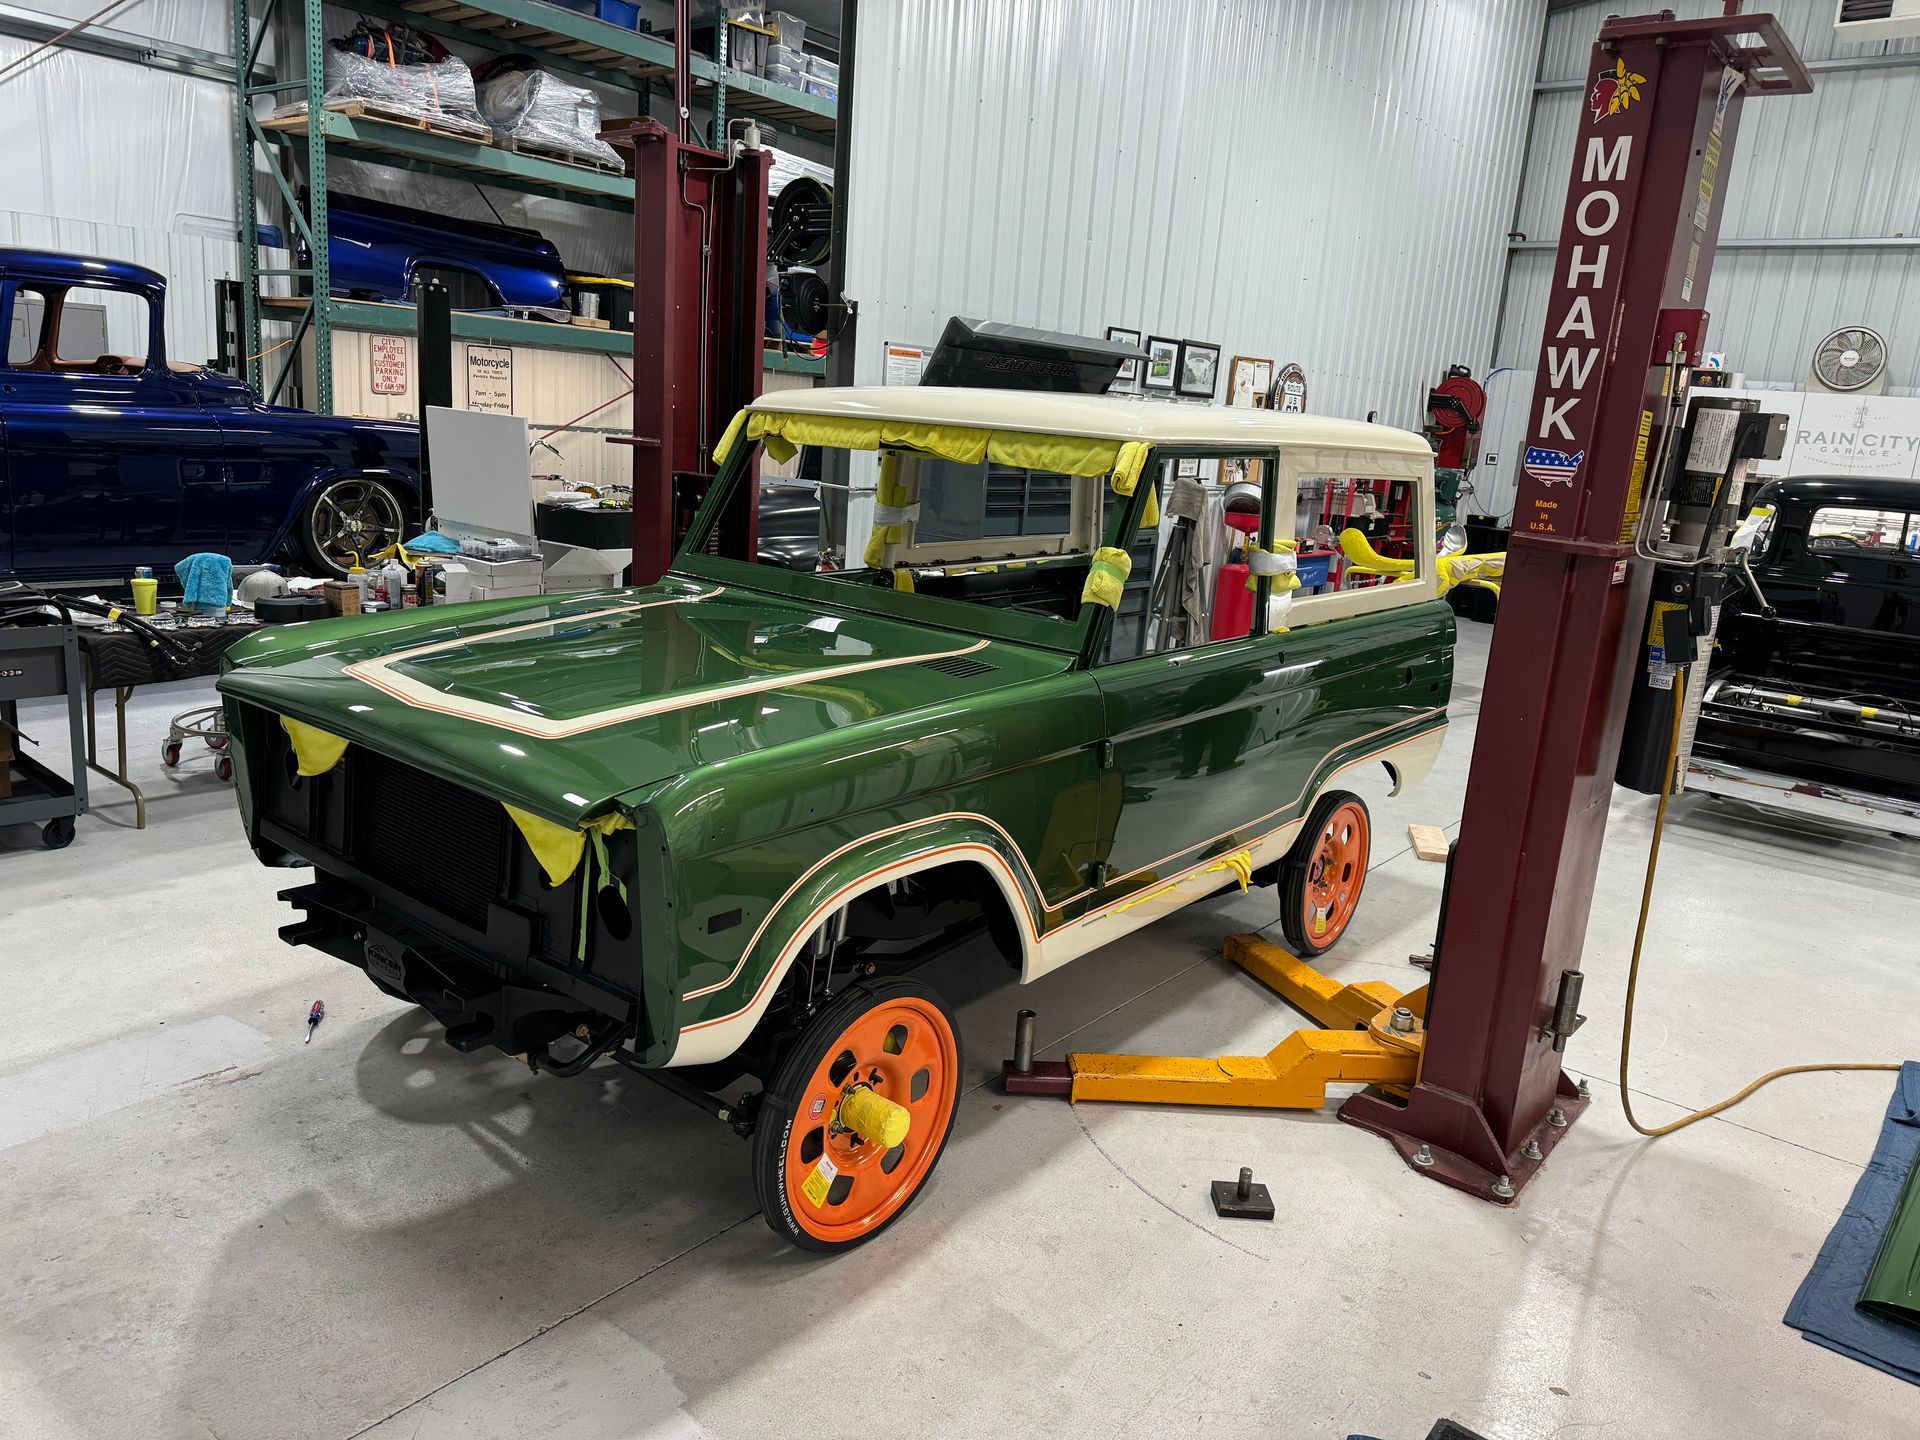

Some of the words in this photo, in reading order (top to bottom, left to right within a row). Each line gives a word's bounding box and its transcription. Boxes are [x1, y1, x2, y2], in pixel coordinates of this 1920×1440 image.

[1538, 135, 1633, 441] MOHAWK
[381, 338, 396, 346] CITY
[373, 345, 405, 354] EMPLOYEE
[383, 353, 396, 361] AND
[374, 360, 405, 369] CUSTOMER
[470, 355, 510, 369] Motorcycle
[375, 367, 404, 376] PARKING
[1012, 358, 1074, 377] GENERAL
[381, 375, 398, 383] ONLY
[375, 382, 384, 390] M-F
[1287, 384, 1302, 393] ROUTE
[1796, 430, 1855, 445] RAIN
[1862, 434, 1920, 452] CITY
[1820, 446, 1890, 457] GARAGE
[1535, 499, 1558, 509] Made
[1530, 522, 1556, 532] U.S.A.
[1650, 676, 1670, 686] VERTICAL
